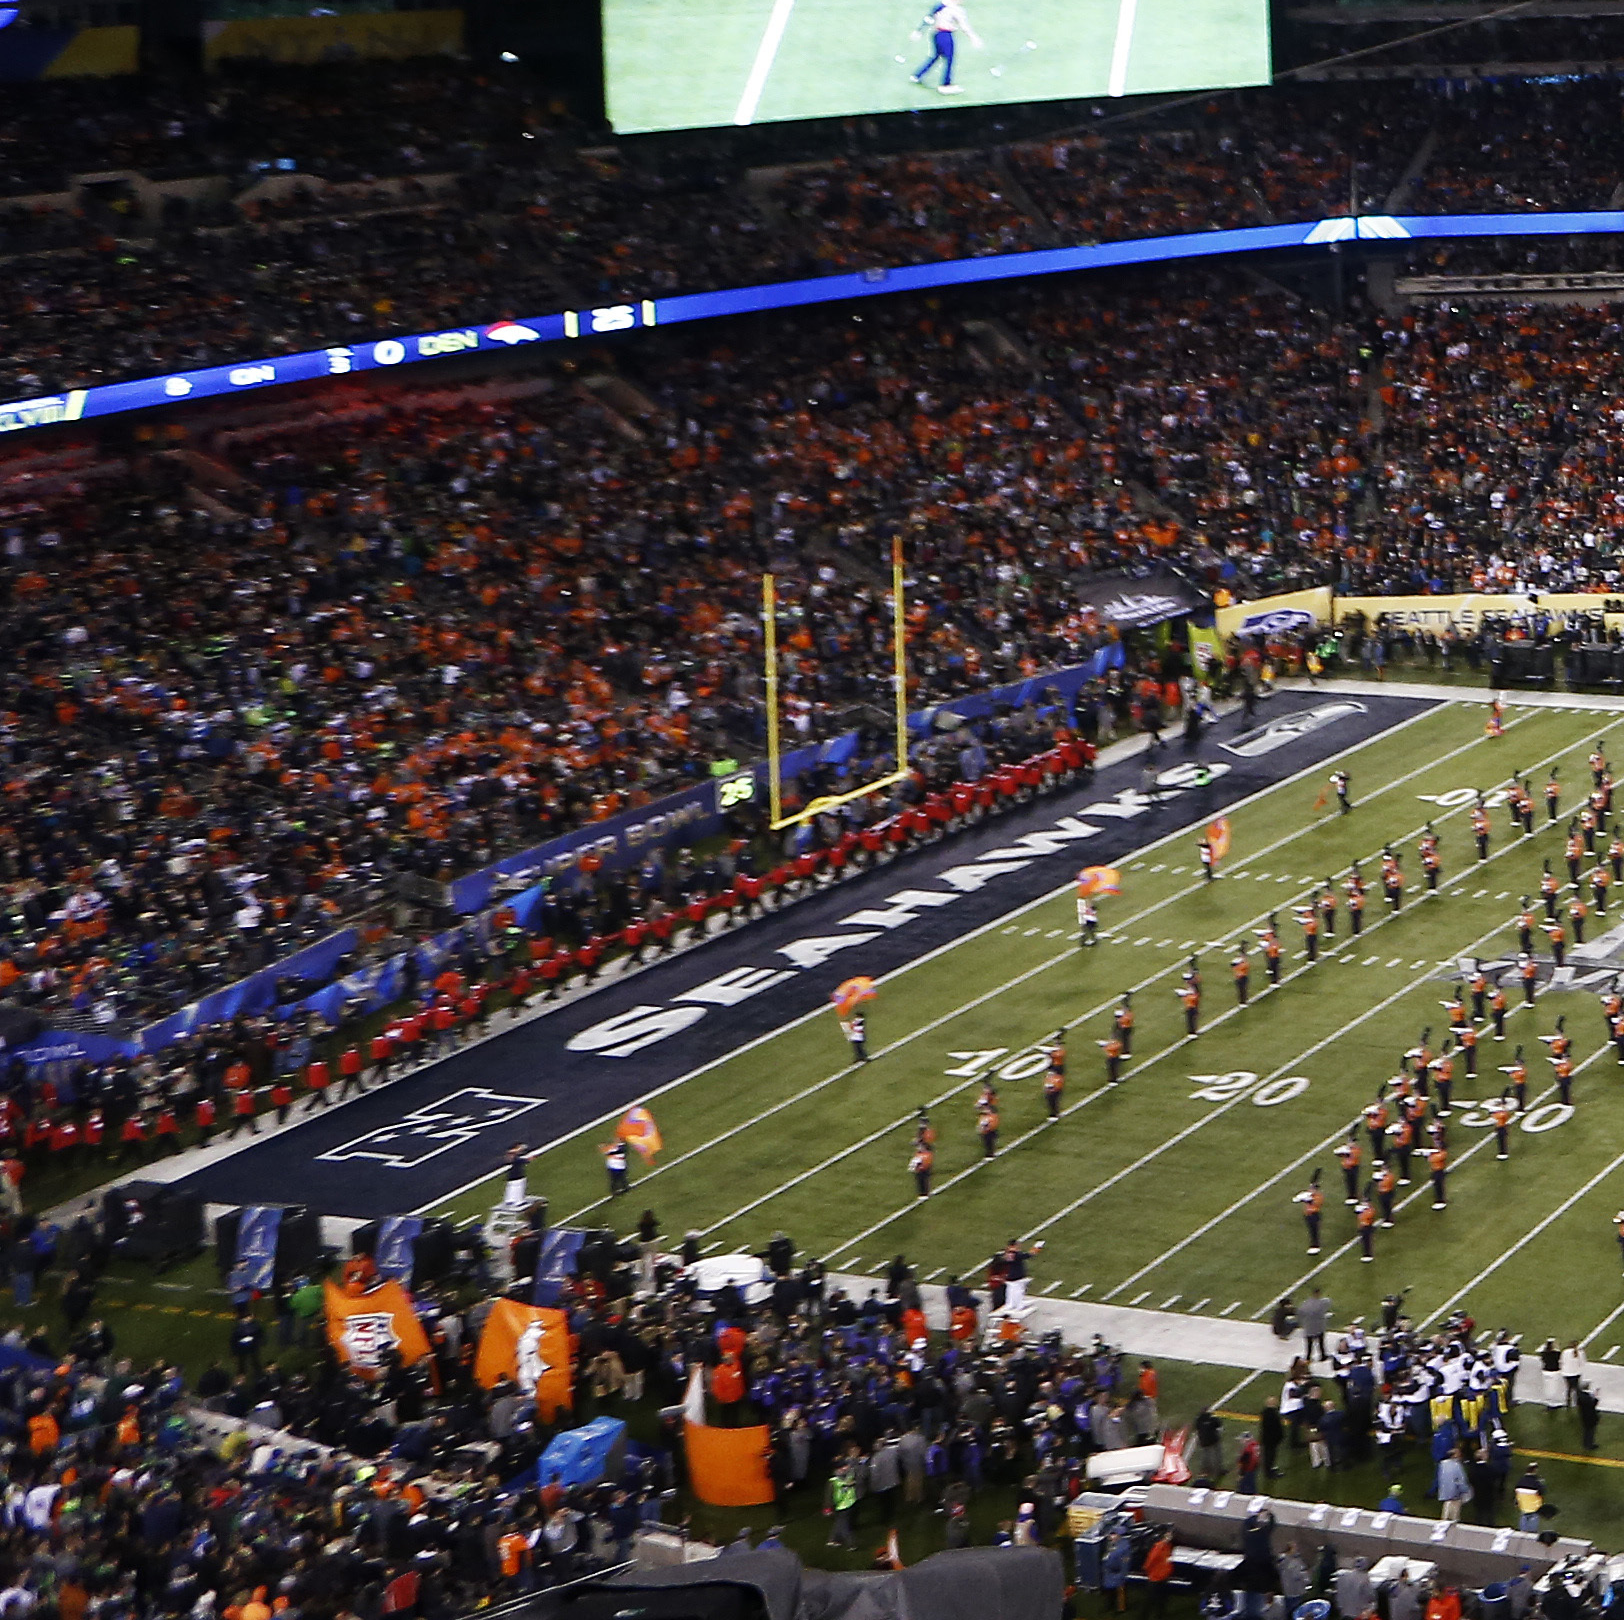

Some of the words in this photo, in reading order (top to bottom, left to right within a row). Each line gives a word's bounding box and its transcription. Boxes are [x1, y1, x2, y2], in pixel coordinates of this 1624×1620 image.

[564, 760, 1232, 1058] SEAHAWKS
[944, 1047, 1053, 1082] 10
[1188, 1070, 1311, 1107] 20
